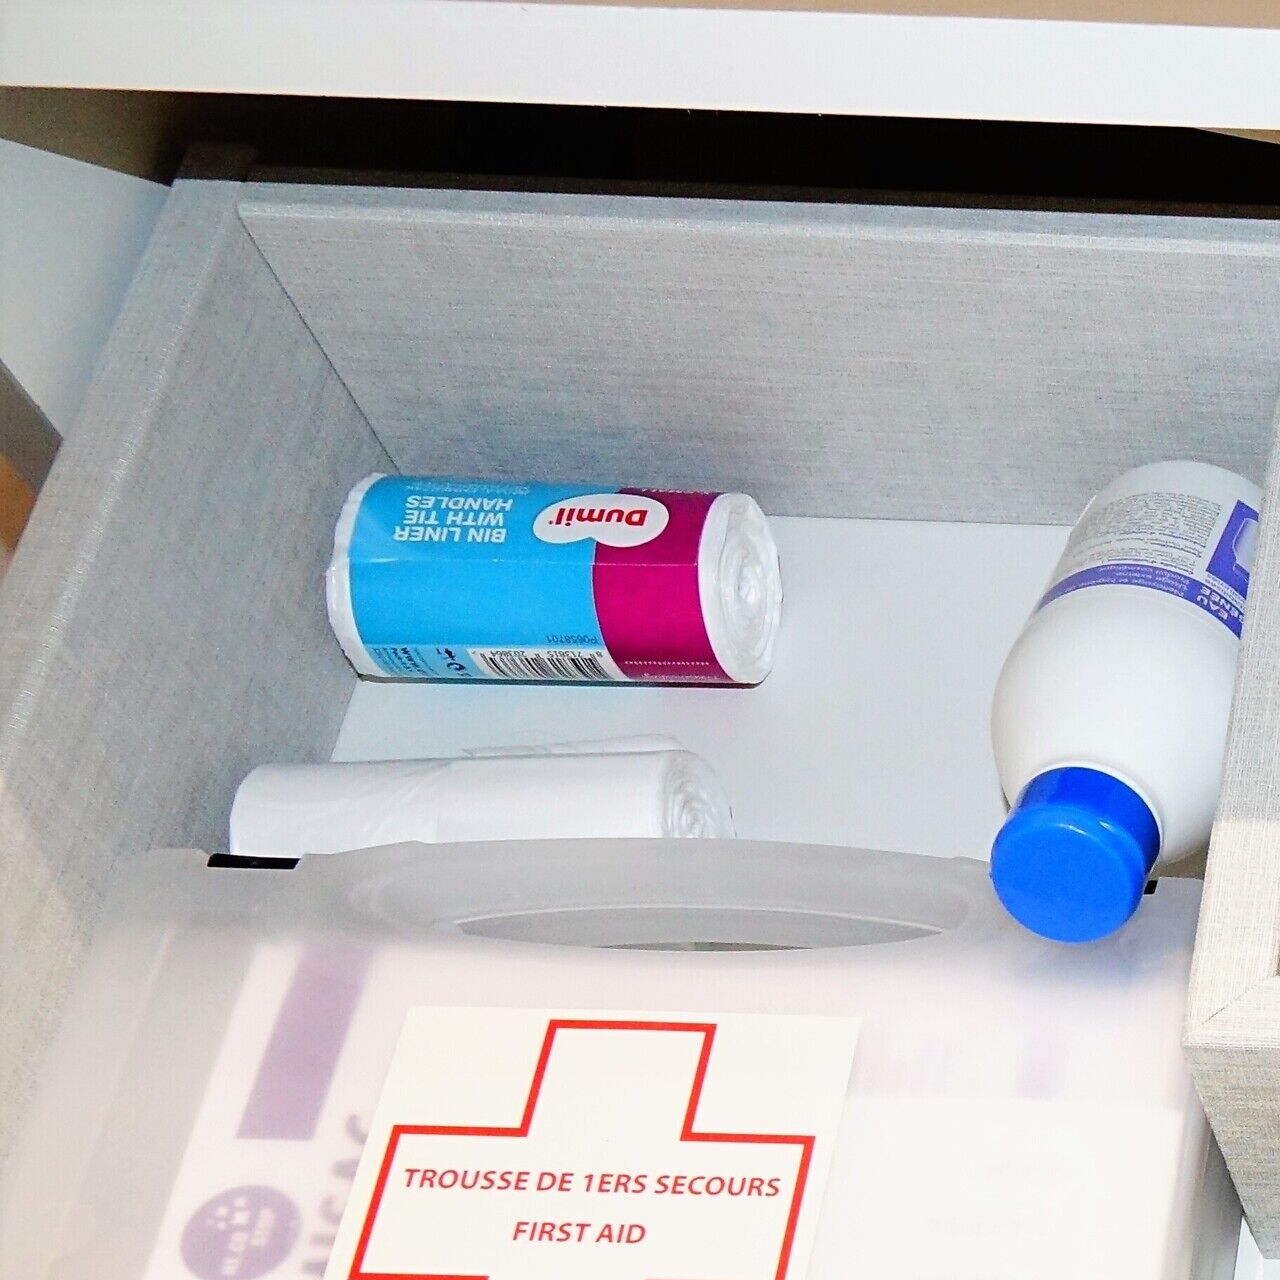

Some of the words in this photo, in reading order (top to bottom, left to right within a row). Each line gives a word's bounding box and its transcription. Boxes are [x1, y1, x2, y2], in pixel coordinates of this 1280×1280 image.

[405, 495, 514, 511] HANDLES
[403, 509, 439, 525] TIE
[447, 509, 504, 526] WITH
[554, 507, 648, 527] Dumil
[394, 525, 461, 543] LINER
[467, 527, 507, 543] BIN
[1196, 594, 1229, 620] EAU
[404, 1168, 531, 1191] TROUSSE
[536, 1172, 575, 1192] DE
[583, 1174, 649, 1194] 1ERS
[654, 1175, 782, 1197] SECOURS
[512, 1221, 592, 1243] FIRST
[596, 1223, 647, 1244] AID
